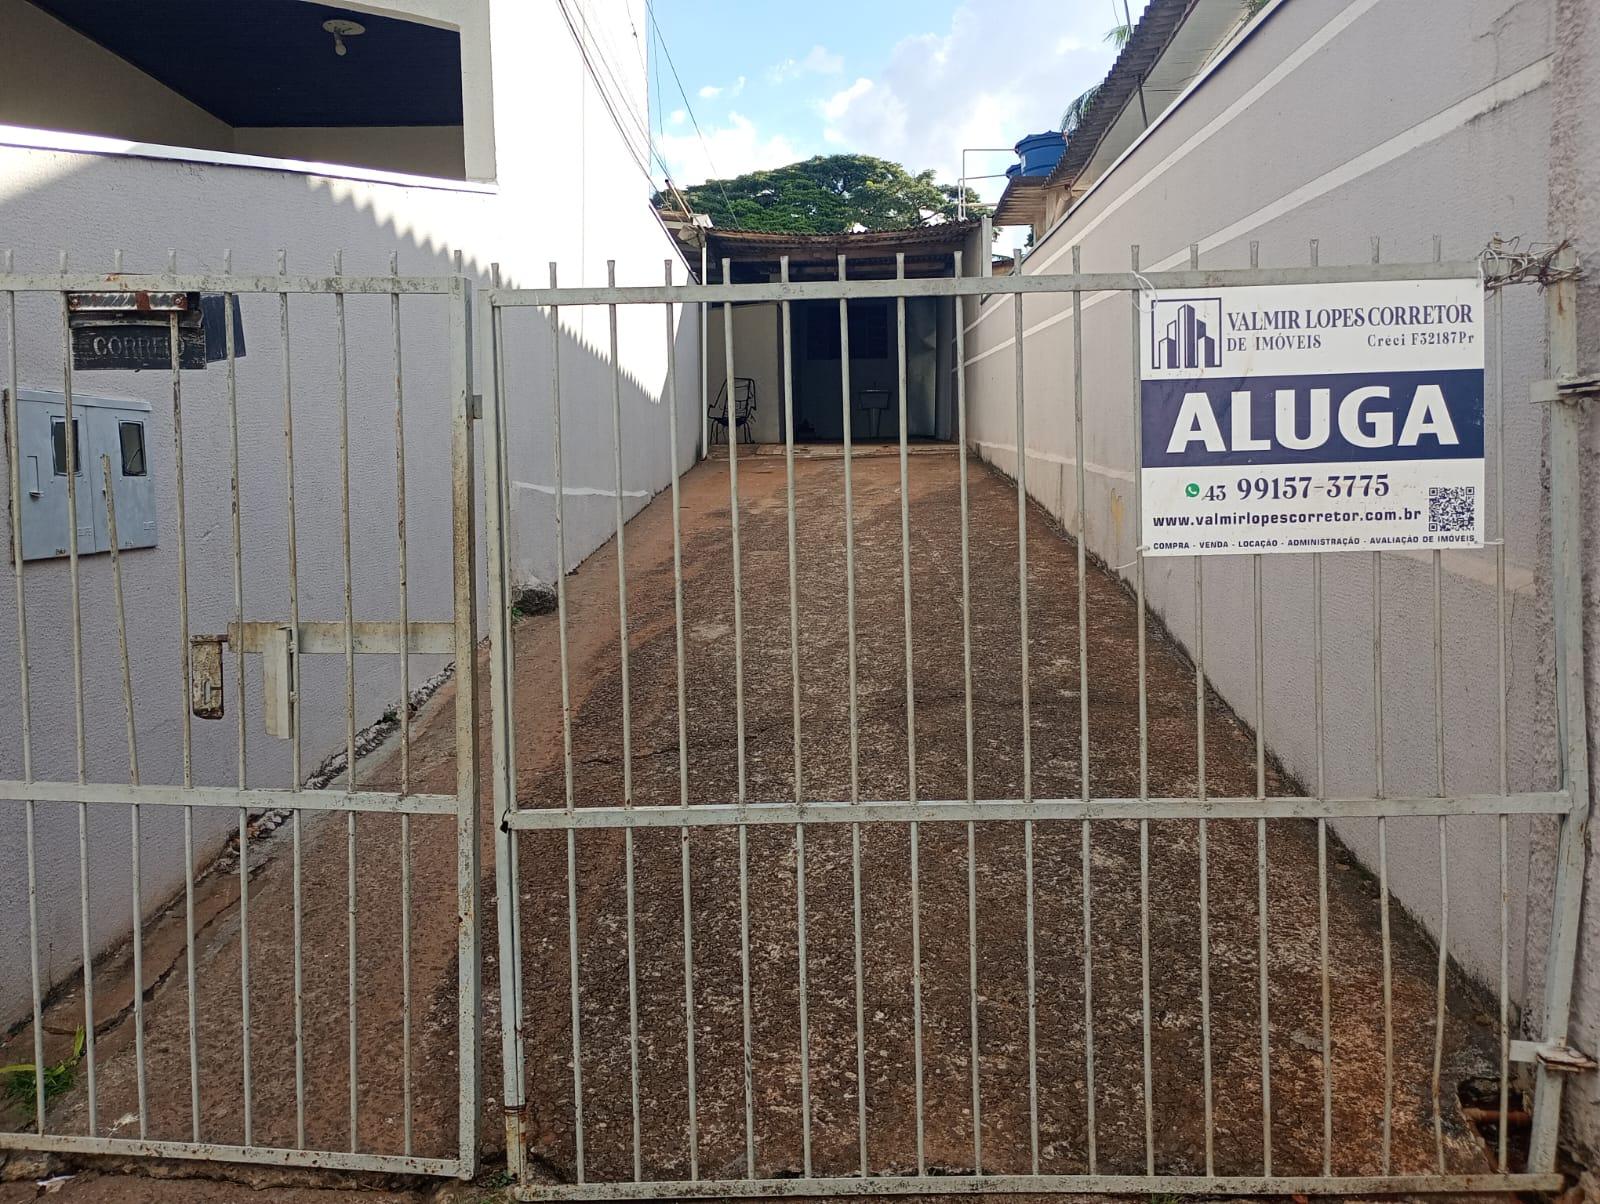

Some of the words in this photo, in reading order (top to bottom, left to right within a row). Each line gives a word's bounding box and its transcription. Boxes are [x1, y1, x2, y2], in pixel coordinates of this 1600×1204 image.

[1227, 310, 1300, 331] VALMIR
[1305, 307, 1365, 328] LOPES
[1368, 304, 1473, 326] CORRETOR
[1226, 337, 1247, 352] DE
[1255, 332, 1322, 351] IMÓVEIS
[1367, 333, 1406, 347] Creci
[1166, 384, 1460, 454] ALUGA
[1202, 485, 1226, 501] 43
[1237, 474, 1390, 500] 99157-3775
[1153, 508, 1421, 526] www.valmirlopescorretor.com.br
[1153, 542, 1190, 550] COMPRA
[1199, 541, 1229, 549] VENDA
[1238, 538, 1278, 548] LOCAÇÃO
[1288, 537, 1360, 547] ADMINISTRAÇÃO
[1369, 535, 1419, 545] AVALIAÇÃO
